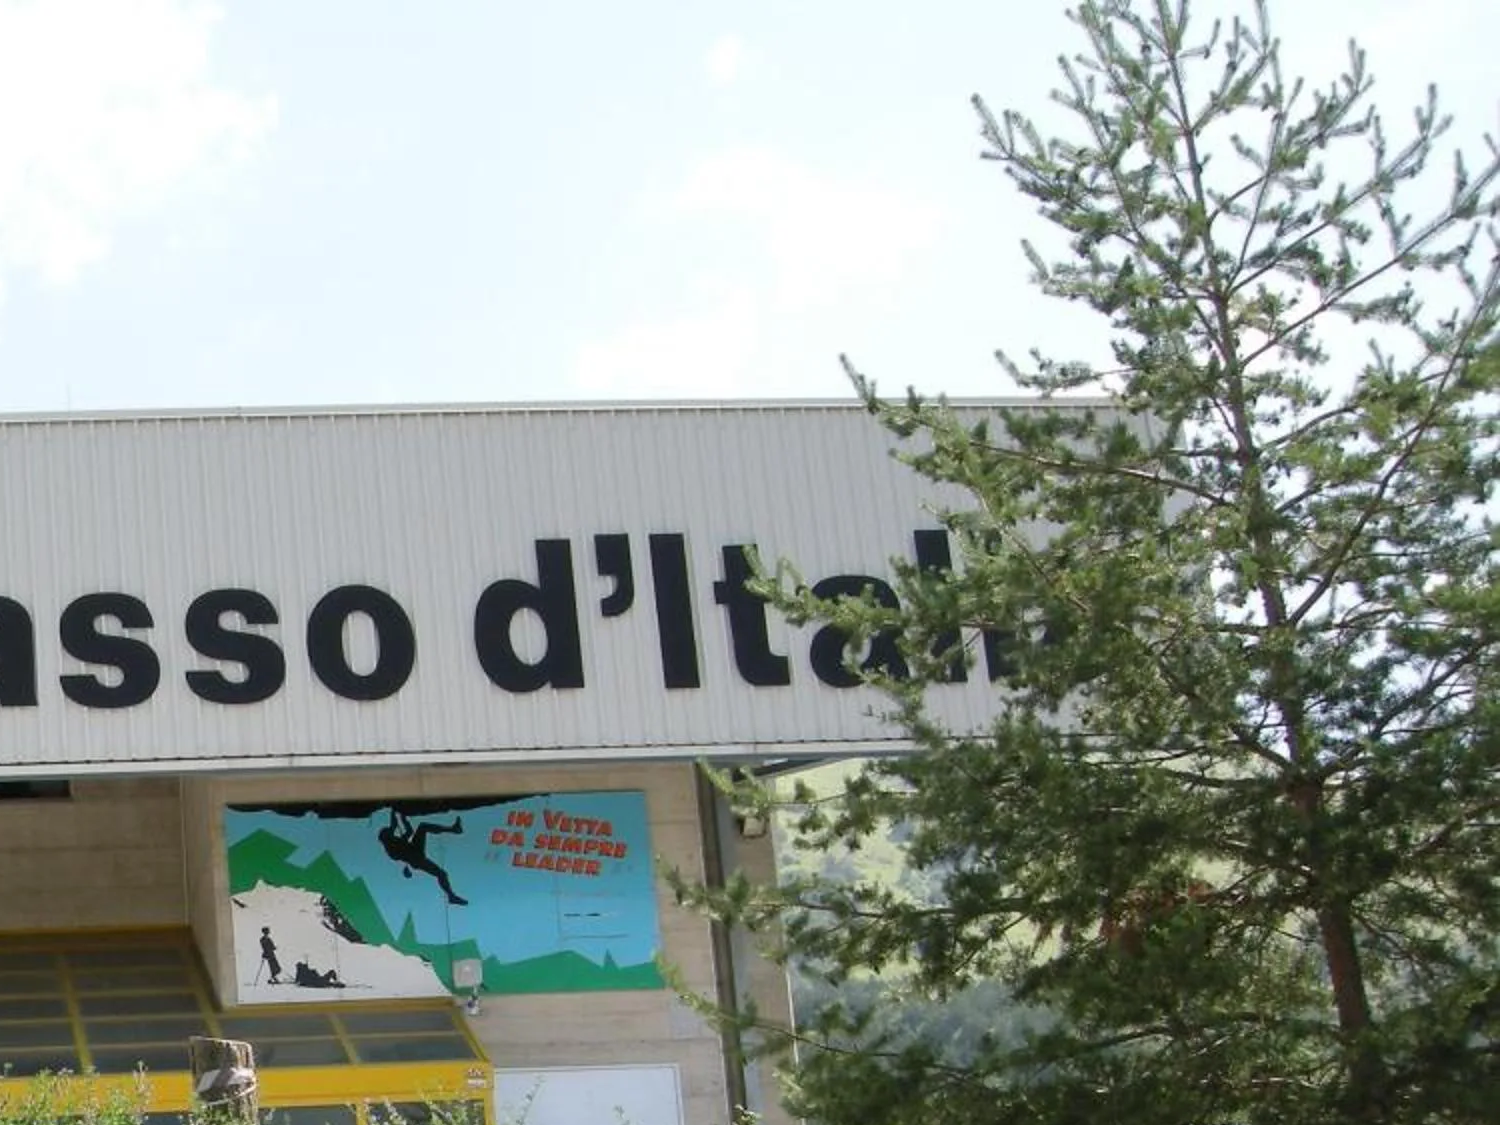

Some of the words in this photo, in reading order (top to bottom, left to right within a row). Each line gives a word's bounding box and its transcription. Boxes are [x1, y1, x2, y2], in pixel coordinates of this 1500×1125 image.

[507, 810, 535, 828] IN
[490, 828, 525, 846] DA
[534, 832, 628, 859] SEMPRE
[512, 851, 602, 876] LEADER
